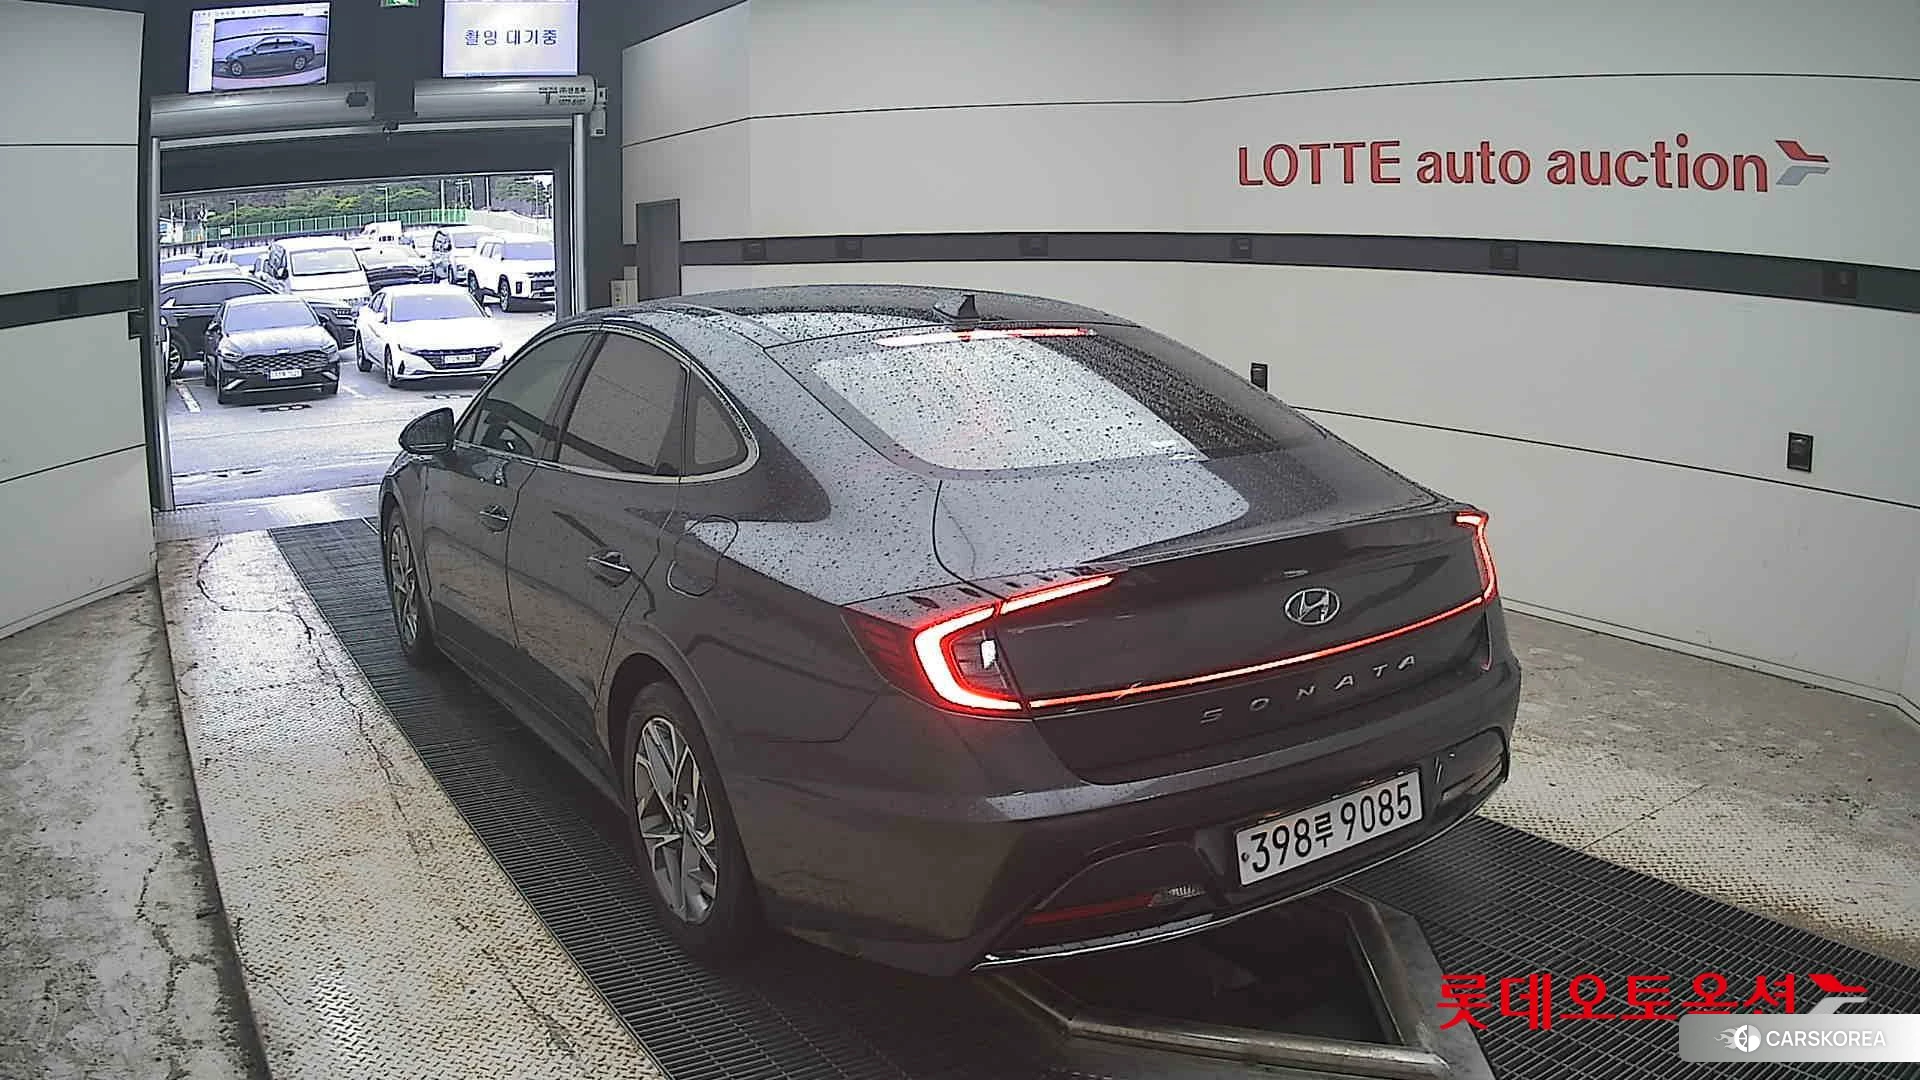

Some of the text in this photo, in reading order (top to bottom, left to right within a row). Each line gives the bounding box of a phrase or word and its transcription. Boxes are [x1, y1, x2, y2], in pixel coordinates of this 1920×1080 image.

[505, 29, 558, 46] 대기중
[1238, 134, 1768, 192] LOTTE auto auction
[1200, 654, 1416, 724] SONATA
[1249, 781, 1413, 873] 398루 9085
